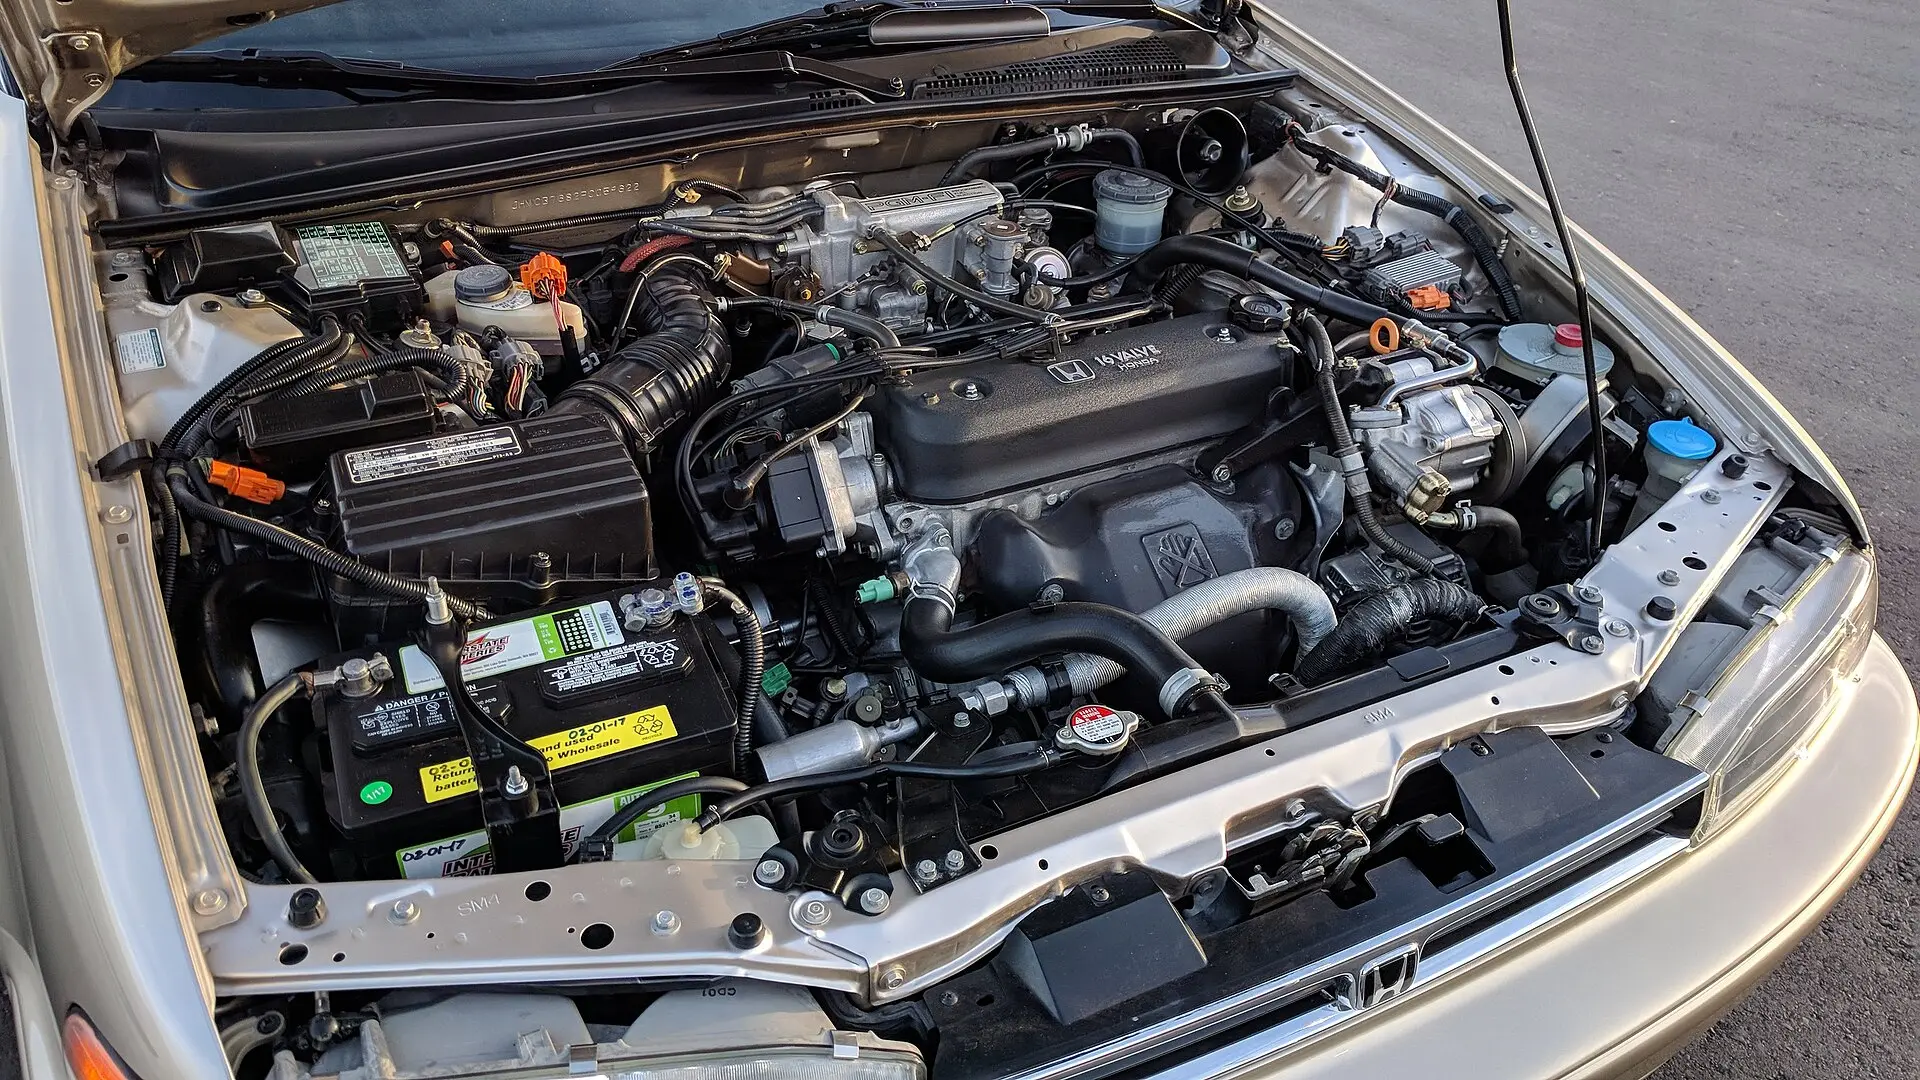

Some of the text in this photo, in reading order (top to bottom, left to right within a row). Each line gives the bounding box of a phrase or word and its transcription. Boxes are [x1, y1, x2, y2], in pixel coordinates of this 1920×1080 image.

[1094, 344, 1161, 367] 16 VALVE
[1117, 357, 1160, 372] HONDA
[386, 695, 428, 710] DANGER
[568, 718, 626, 740] 02-01-17
[558, 737, 620, 760] Wholesale
[565, 733, 594, 748] used
[429, 758, 471, 776] 02-0
[366, 786, 386, 801] 1/17
[435, 777, 477, 793] batteri
[458, 893, 500, 917] SM4
